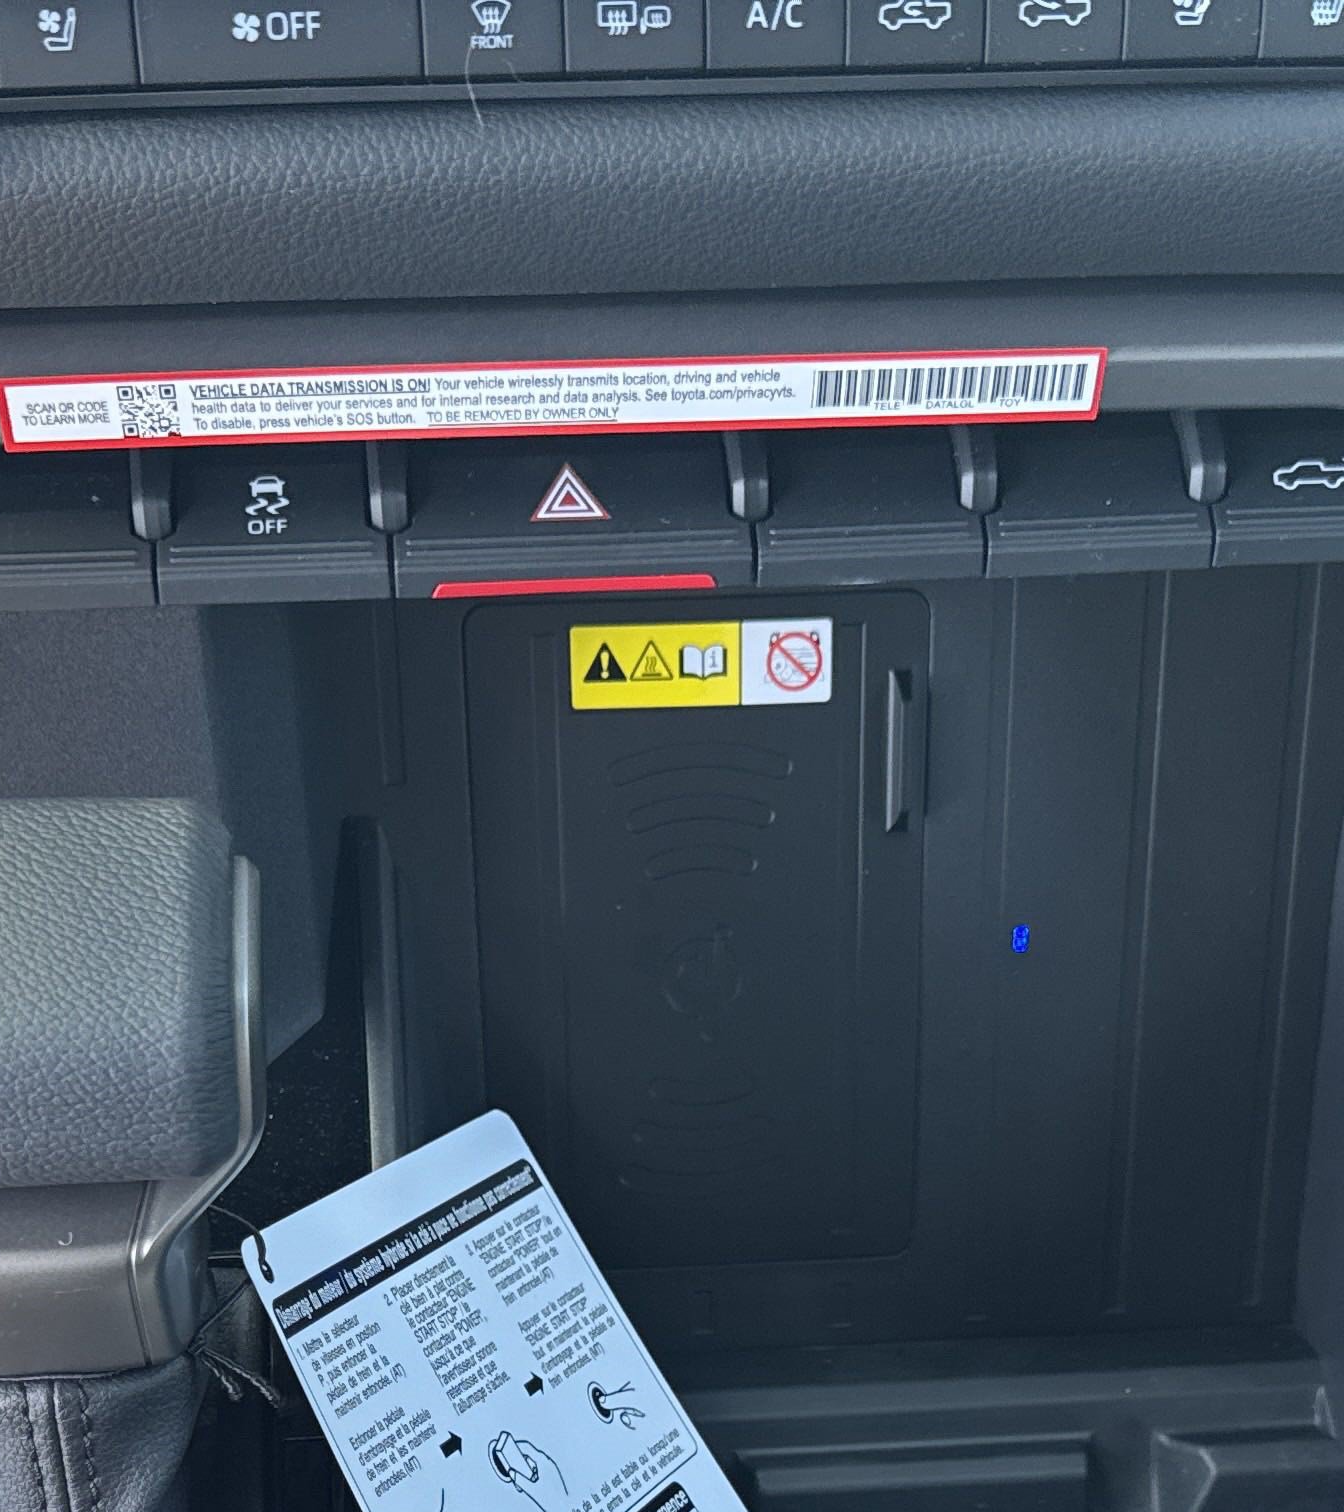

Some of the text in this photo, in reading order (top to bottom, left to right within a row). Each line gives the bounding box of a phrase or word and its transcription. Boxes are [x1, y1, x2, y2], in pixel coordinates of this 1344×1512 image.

[746, 0, 803, 30] A/C
[266, 11, 320, 40] OFF
[470, 35, 513, 49] FRONT
[189, 368, 780, 398] VEHICLE DATA TRANSMISSION IS ON! Your vehicle wirelessly transmits location, driving and vehicle
[26, 402, 56, 414] SCAN
[78, 401, 109, 412] CODE
[191, 400, 227, 414] health
[230, 400, 256, 413] data
[260, 401, 272, 412] to
[275, 399, 313, 412] deliver
[316, 401, 342, 415] your
[345, 397, 393, 410] services
[396, 396, 418, 408] and
[421, 395, 436, 408] for
[440, 393, 484, 407] internal
[486, 391, 535, 405] research
[539, 391, 560, 404] and
[563, 390, 588, 403] data
[592, 389, 641, 406] analysis.
[645, 388, 667, 401] See
[874, 401, 900, 411] TELE
[999, 398, 1022, 408] TOY
[22, 413, 110, 426] TO LEARN MORE
[194, 406, 620, 431] To disable, press vehicle's SOS button. TO BE REMOVED BY OWNER ONLY
[247, 519, 288, 535] OFF
